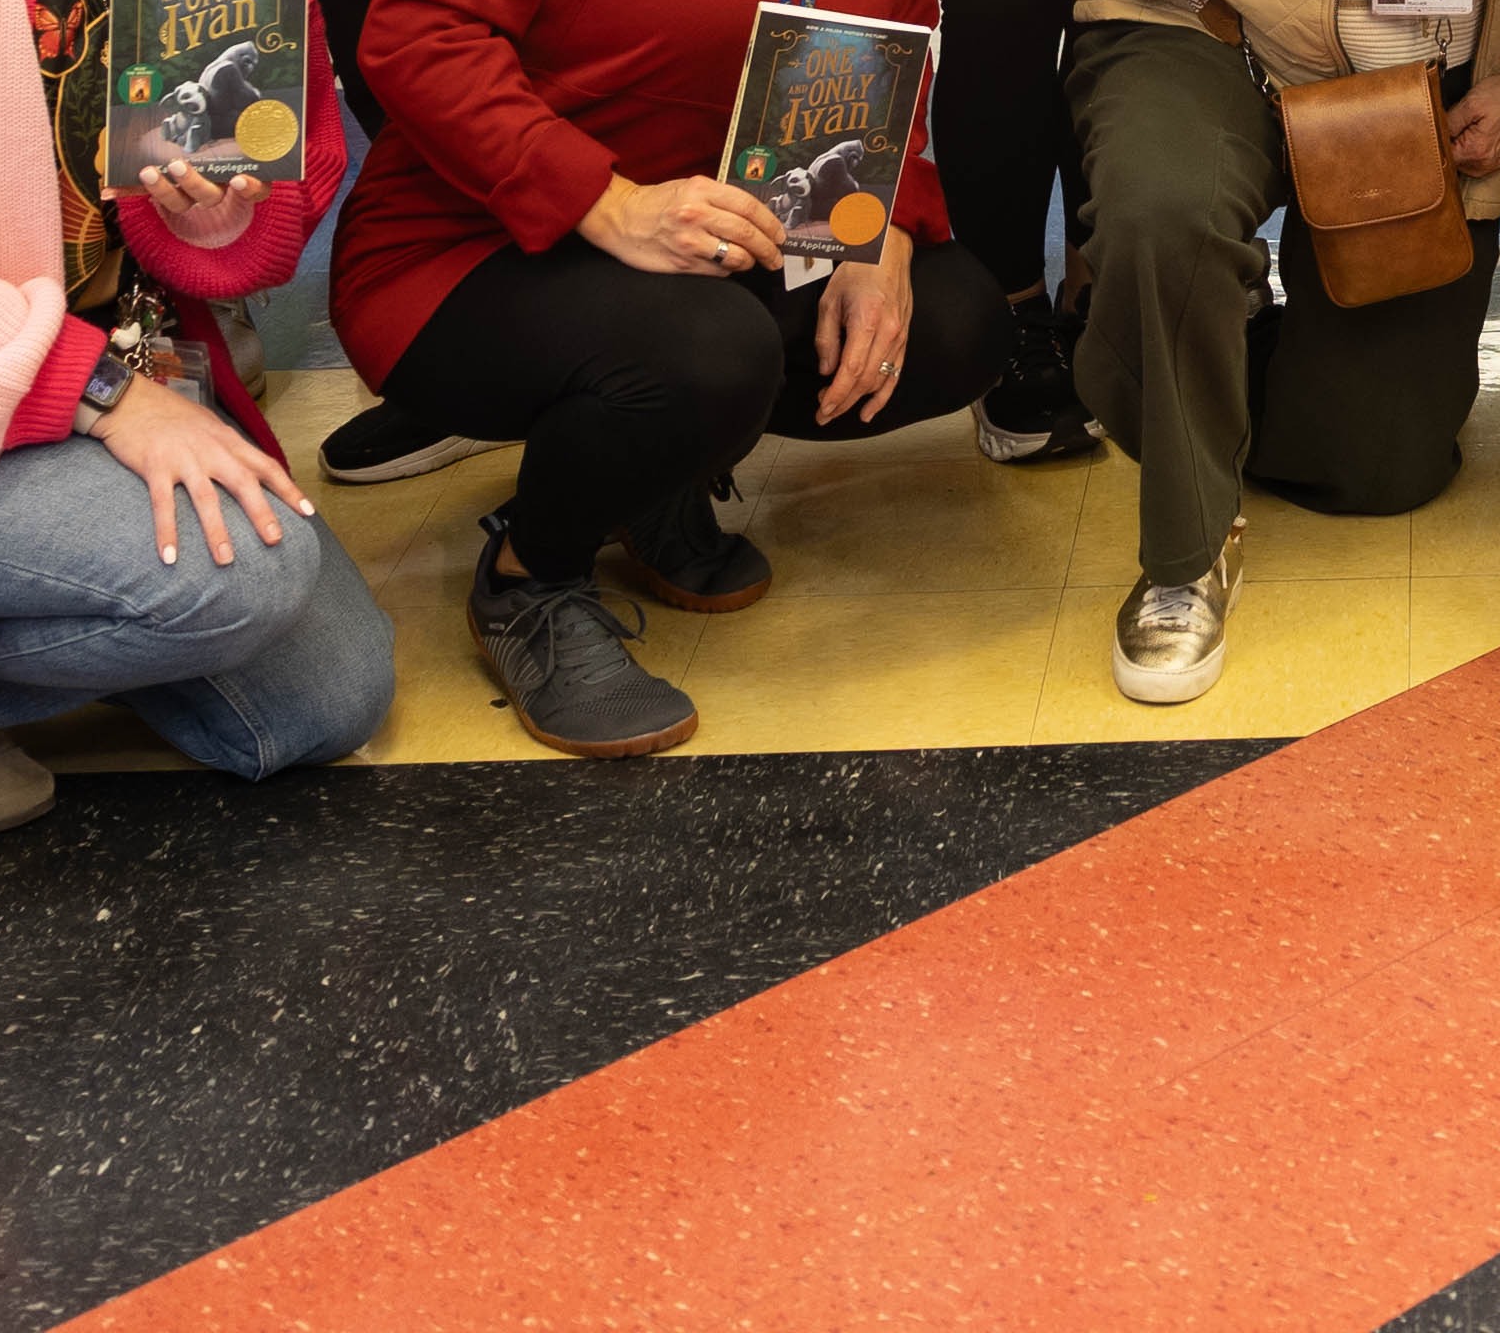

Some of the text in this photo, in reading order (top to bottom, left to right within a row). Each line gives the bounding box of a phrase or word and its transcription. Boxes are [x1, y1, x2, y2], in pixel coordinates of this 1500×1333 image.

[806, 47, 855, 78] ONE
[808, 73, 876, 107] ONLY
[779, 97, 871, 147] Ivan
[207, 163, 259, 173] Applegate
[801, 240, 845, 253] Applegate
